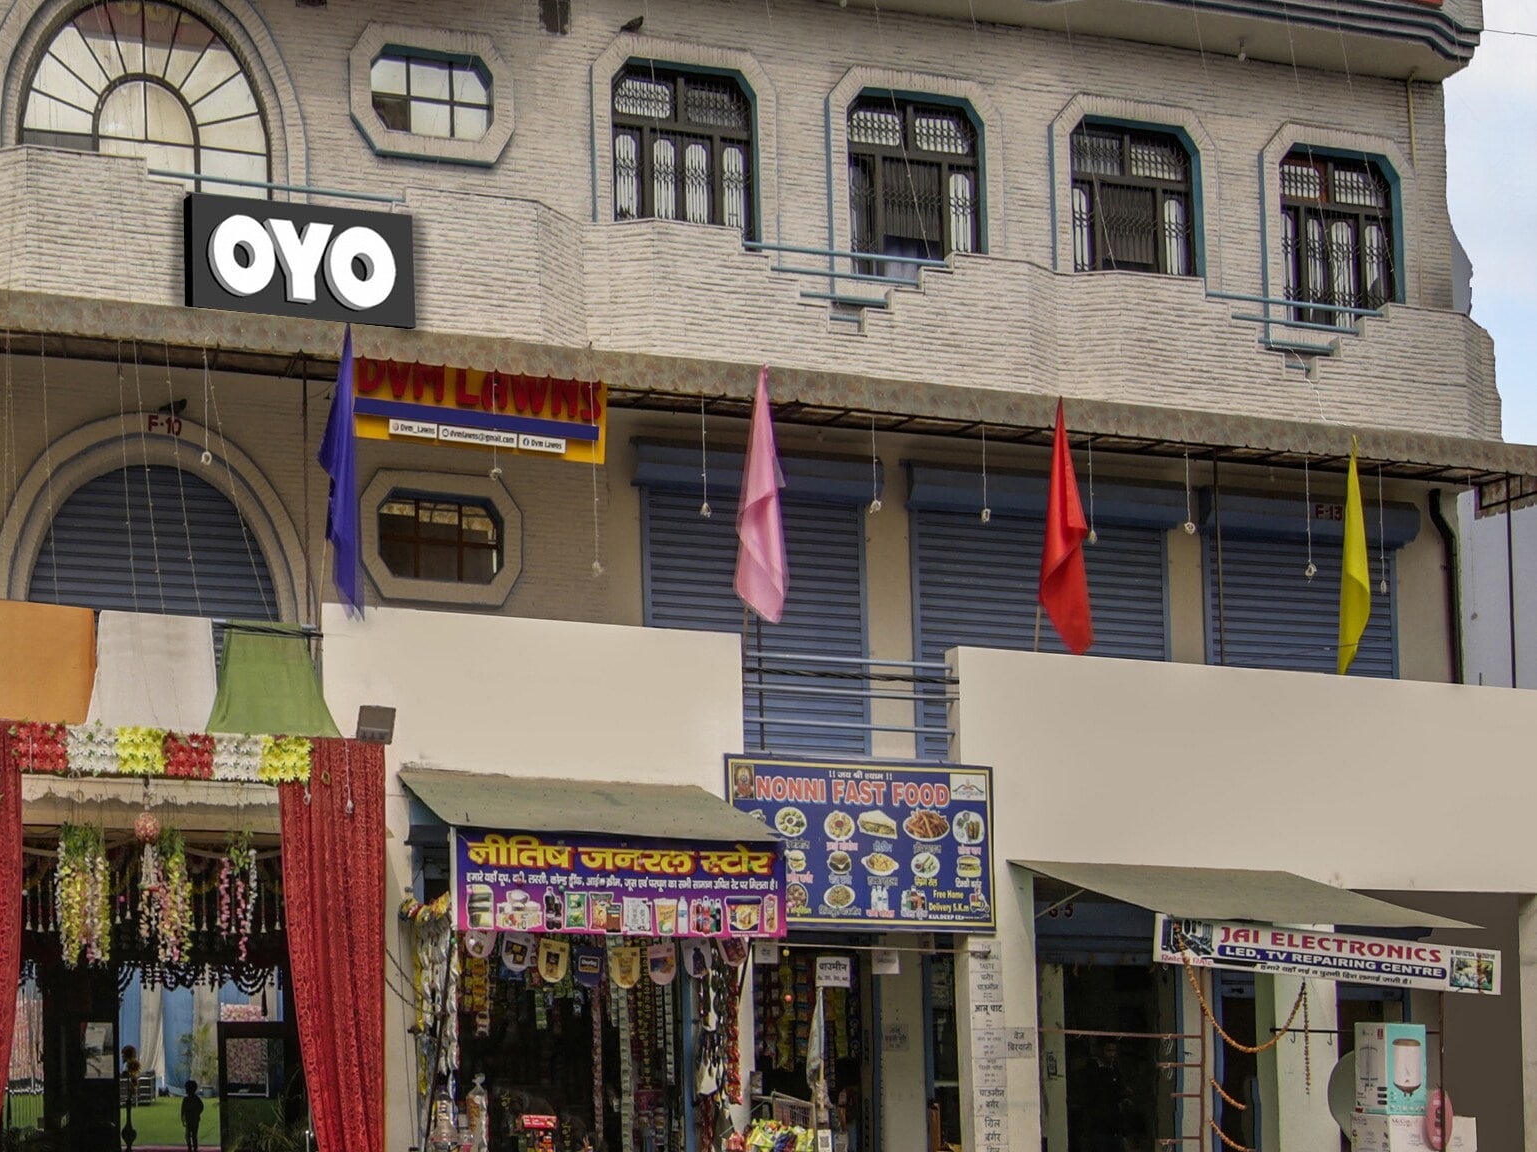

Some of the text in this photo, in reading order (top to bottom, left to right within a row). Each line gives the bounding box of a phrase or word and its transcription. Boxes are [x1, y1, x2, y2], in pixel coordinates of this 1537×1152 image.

[206, 214, 396, 311] OYO
[358, 358, 601, 421] DVM LAWNS
[1315, 503, 1344, 521] F-13
[756, 776, 950, 807] NONNI FAST FOOD
[578, 846, 694, 873] जनरल
[933, 890, 964, 899] Free Home
[1221, 927, 1259, 943] JAI
[1271, 932, 1441, 963] ELECTRONICS
[1225, 946, 1442, 977] LED, TV REPAIRING CENTRE
